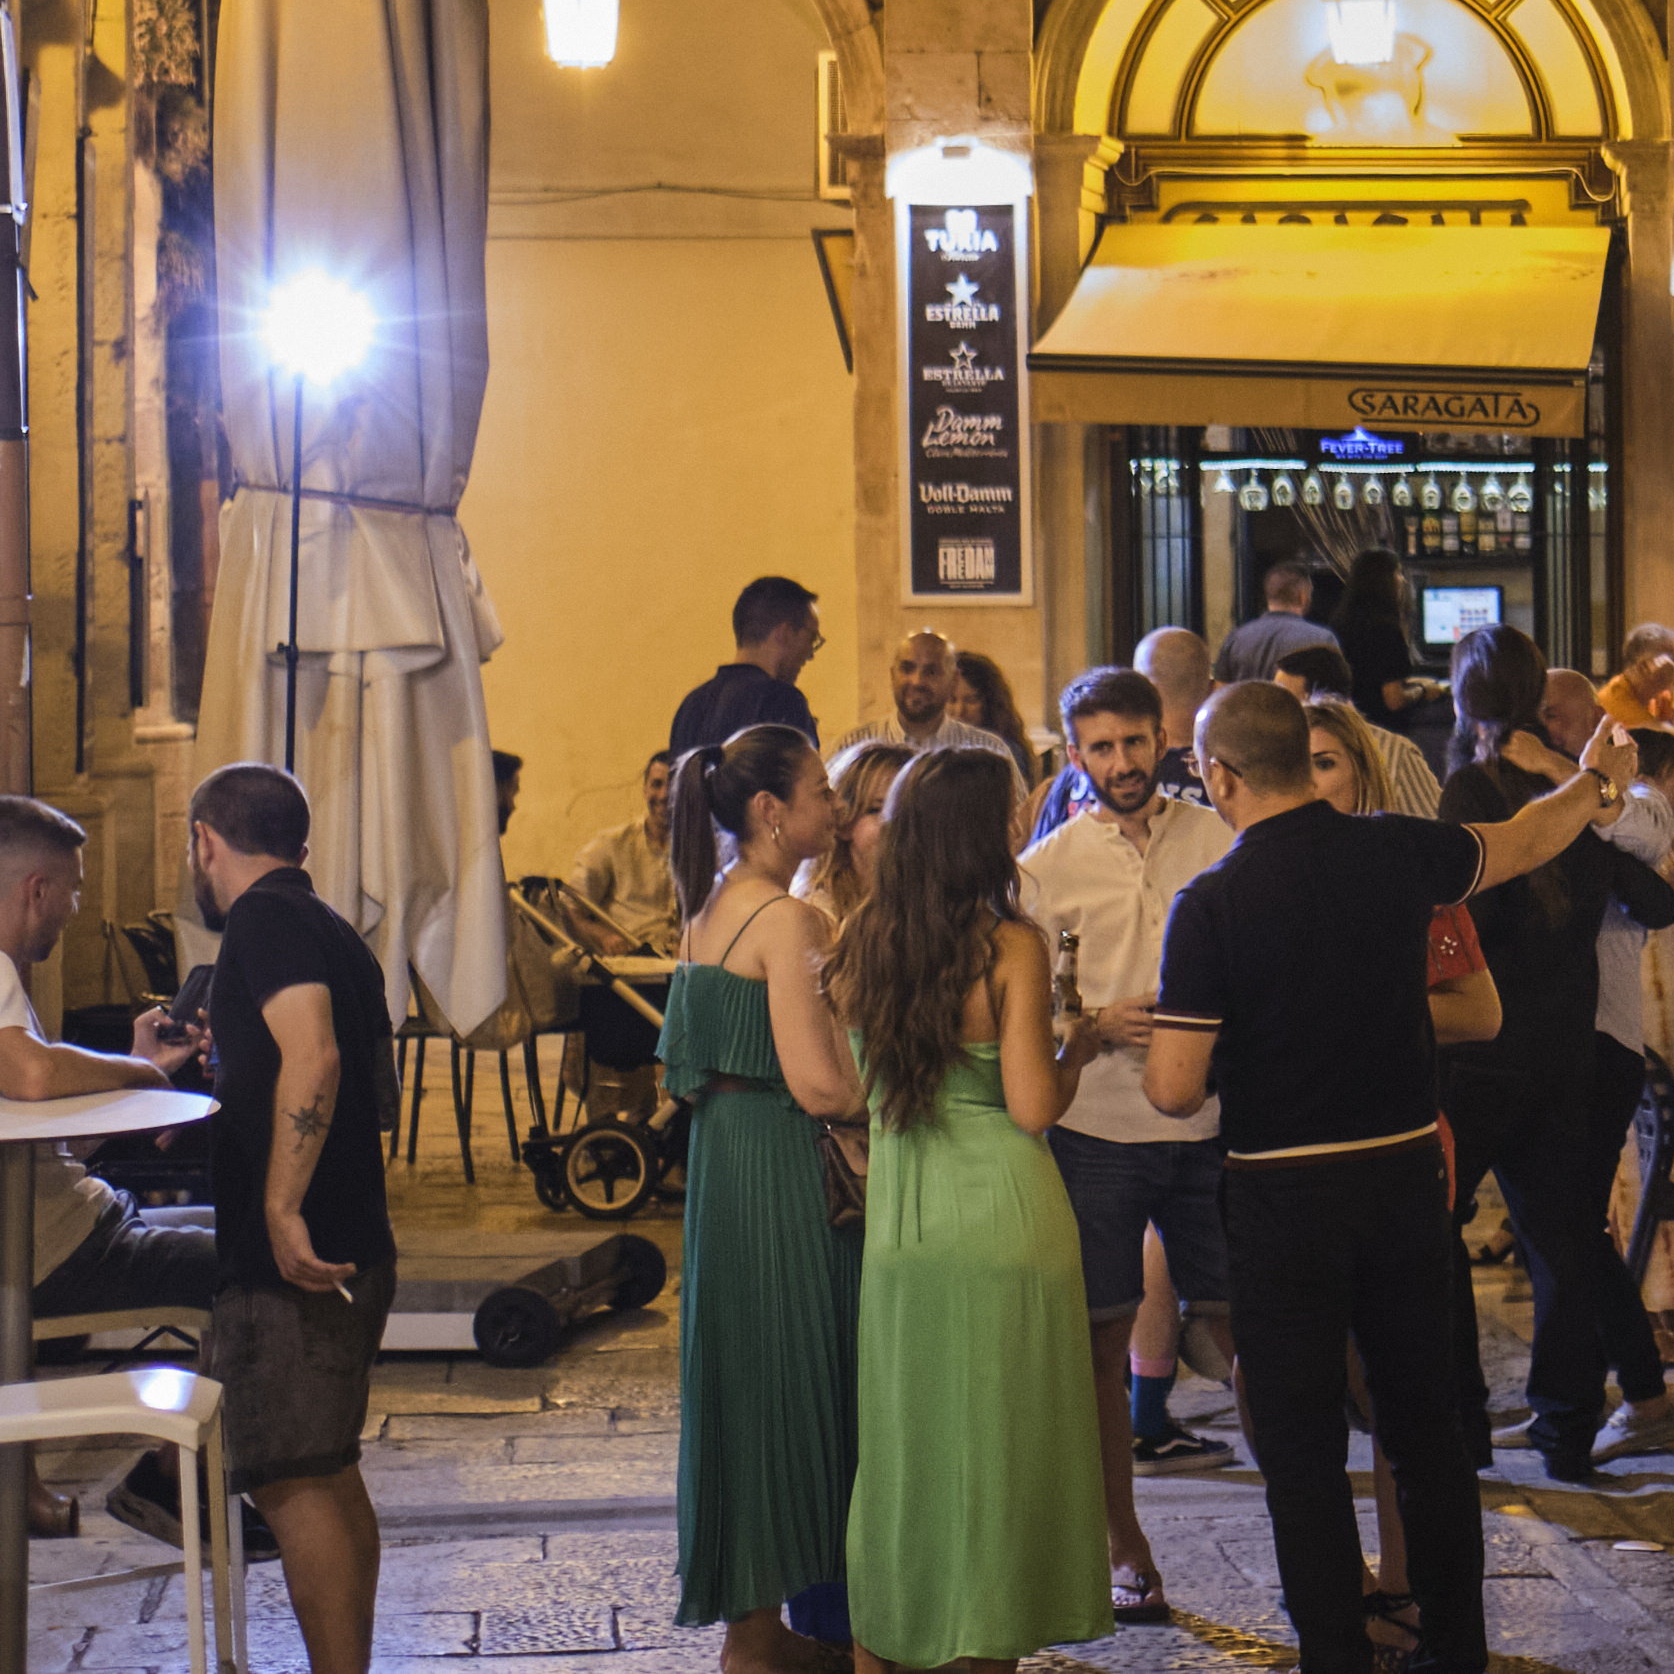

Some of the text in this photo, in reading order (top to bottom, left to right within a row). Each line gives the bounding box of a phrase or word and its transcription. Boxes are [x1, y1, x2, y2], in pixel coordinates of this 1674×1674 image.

[923, 228, 1000, 253] TURIA
[925, 303, 1001, 322] ESTRELLA
[922, 367, 1006, 381] ESTRELLA
[1361, 393, 1528, 421] SARAGATA
[936, 405, 1003, 432] Damm
[922, 421, 996, 448] Lemon
[1320, 438, 1404, 454] FEVER-TREE
[919, 482, 1013, 503] Voll-Damm
[927, 505, 1005, 514] DOBLE MALTA
